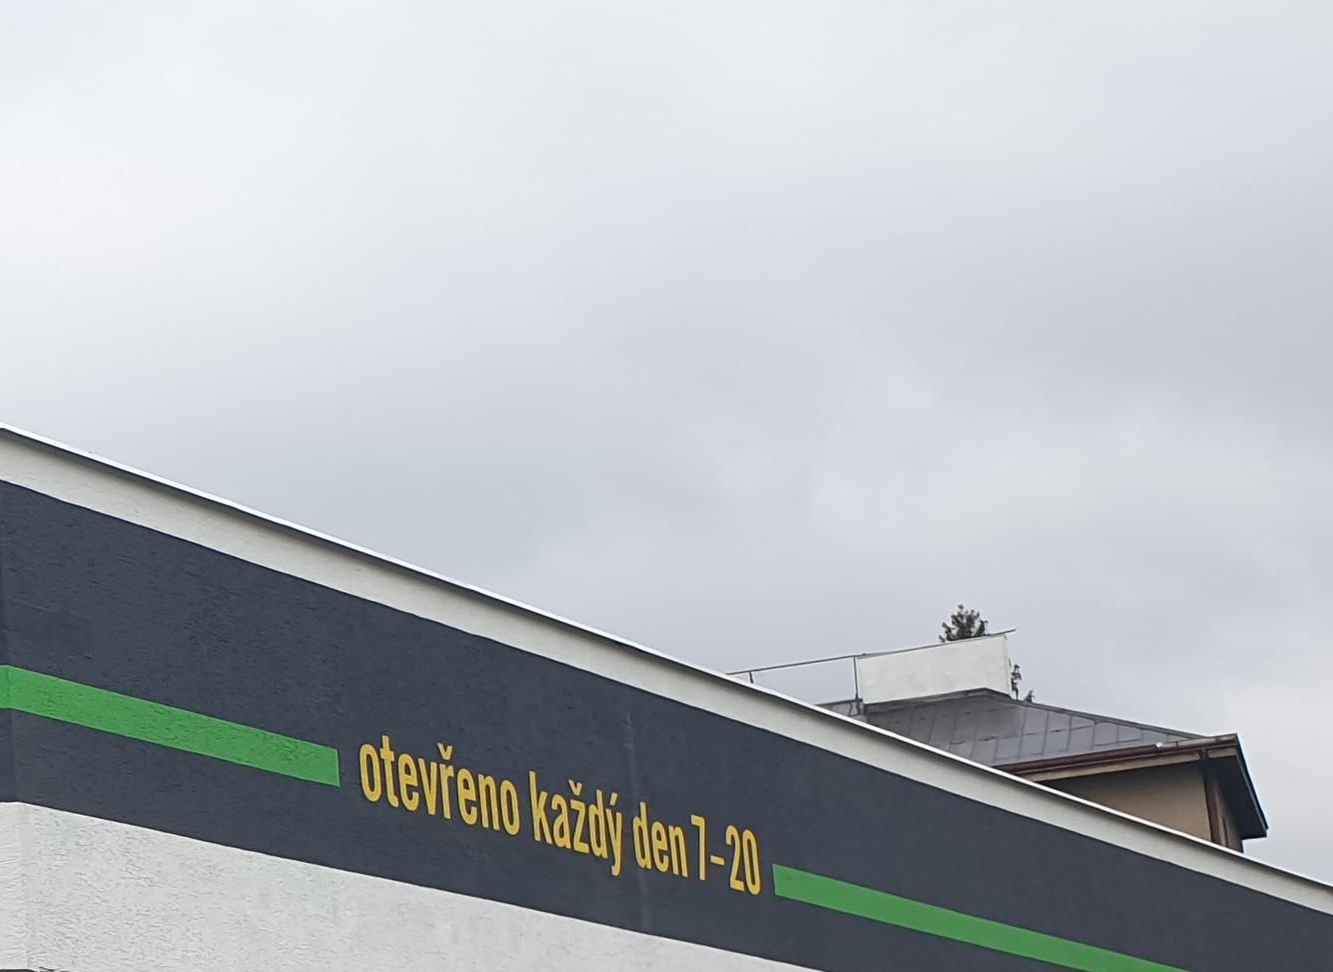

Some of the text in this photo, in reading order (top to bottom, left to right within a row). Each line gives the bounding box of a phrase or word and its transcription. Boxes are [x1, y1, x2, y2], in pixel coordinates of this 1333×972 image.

[359, 735, 521, 836] otevřeno
[529, 771, 622, 877] každý
[633, 801, 688, 878] den
